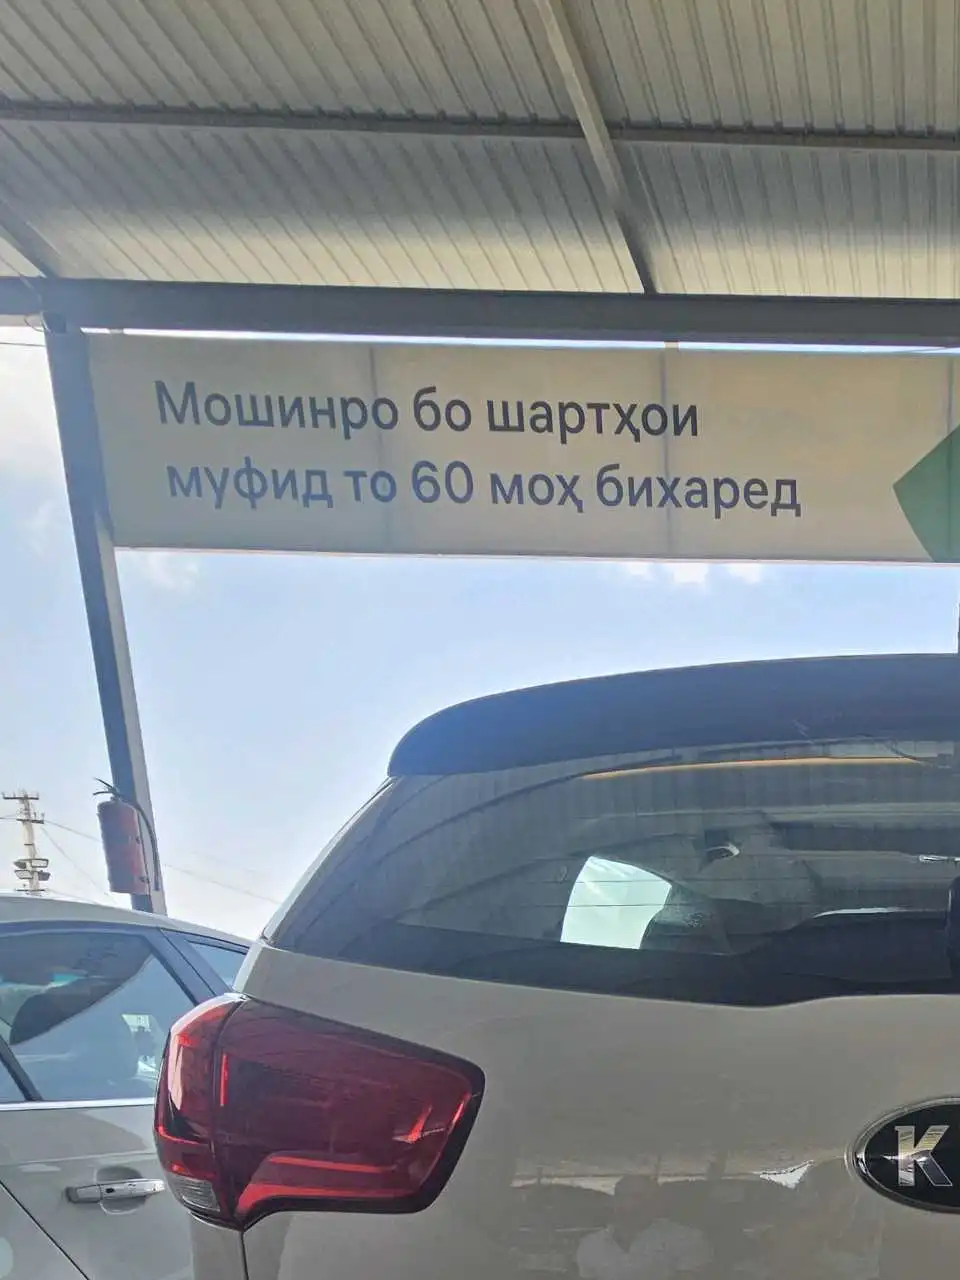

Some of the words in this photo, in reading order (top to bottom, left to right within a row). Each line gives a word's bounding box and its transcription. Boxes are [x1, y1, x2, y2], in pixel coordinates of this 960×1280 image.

[153, 380, 399, 439] Мошинро
[412, 387, 473, 433] бо
[487, 399, 699, 447] шартҳои
[167, 455, 334, 510] муфид
[344, 467, 398, 504] то
[411, 460, 474, 505] 60
[489, 472, 583, 515] моҳ
[596, 463, 802, 519] бихаред
